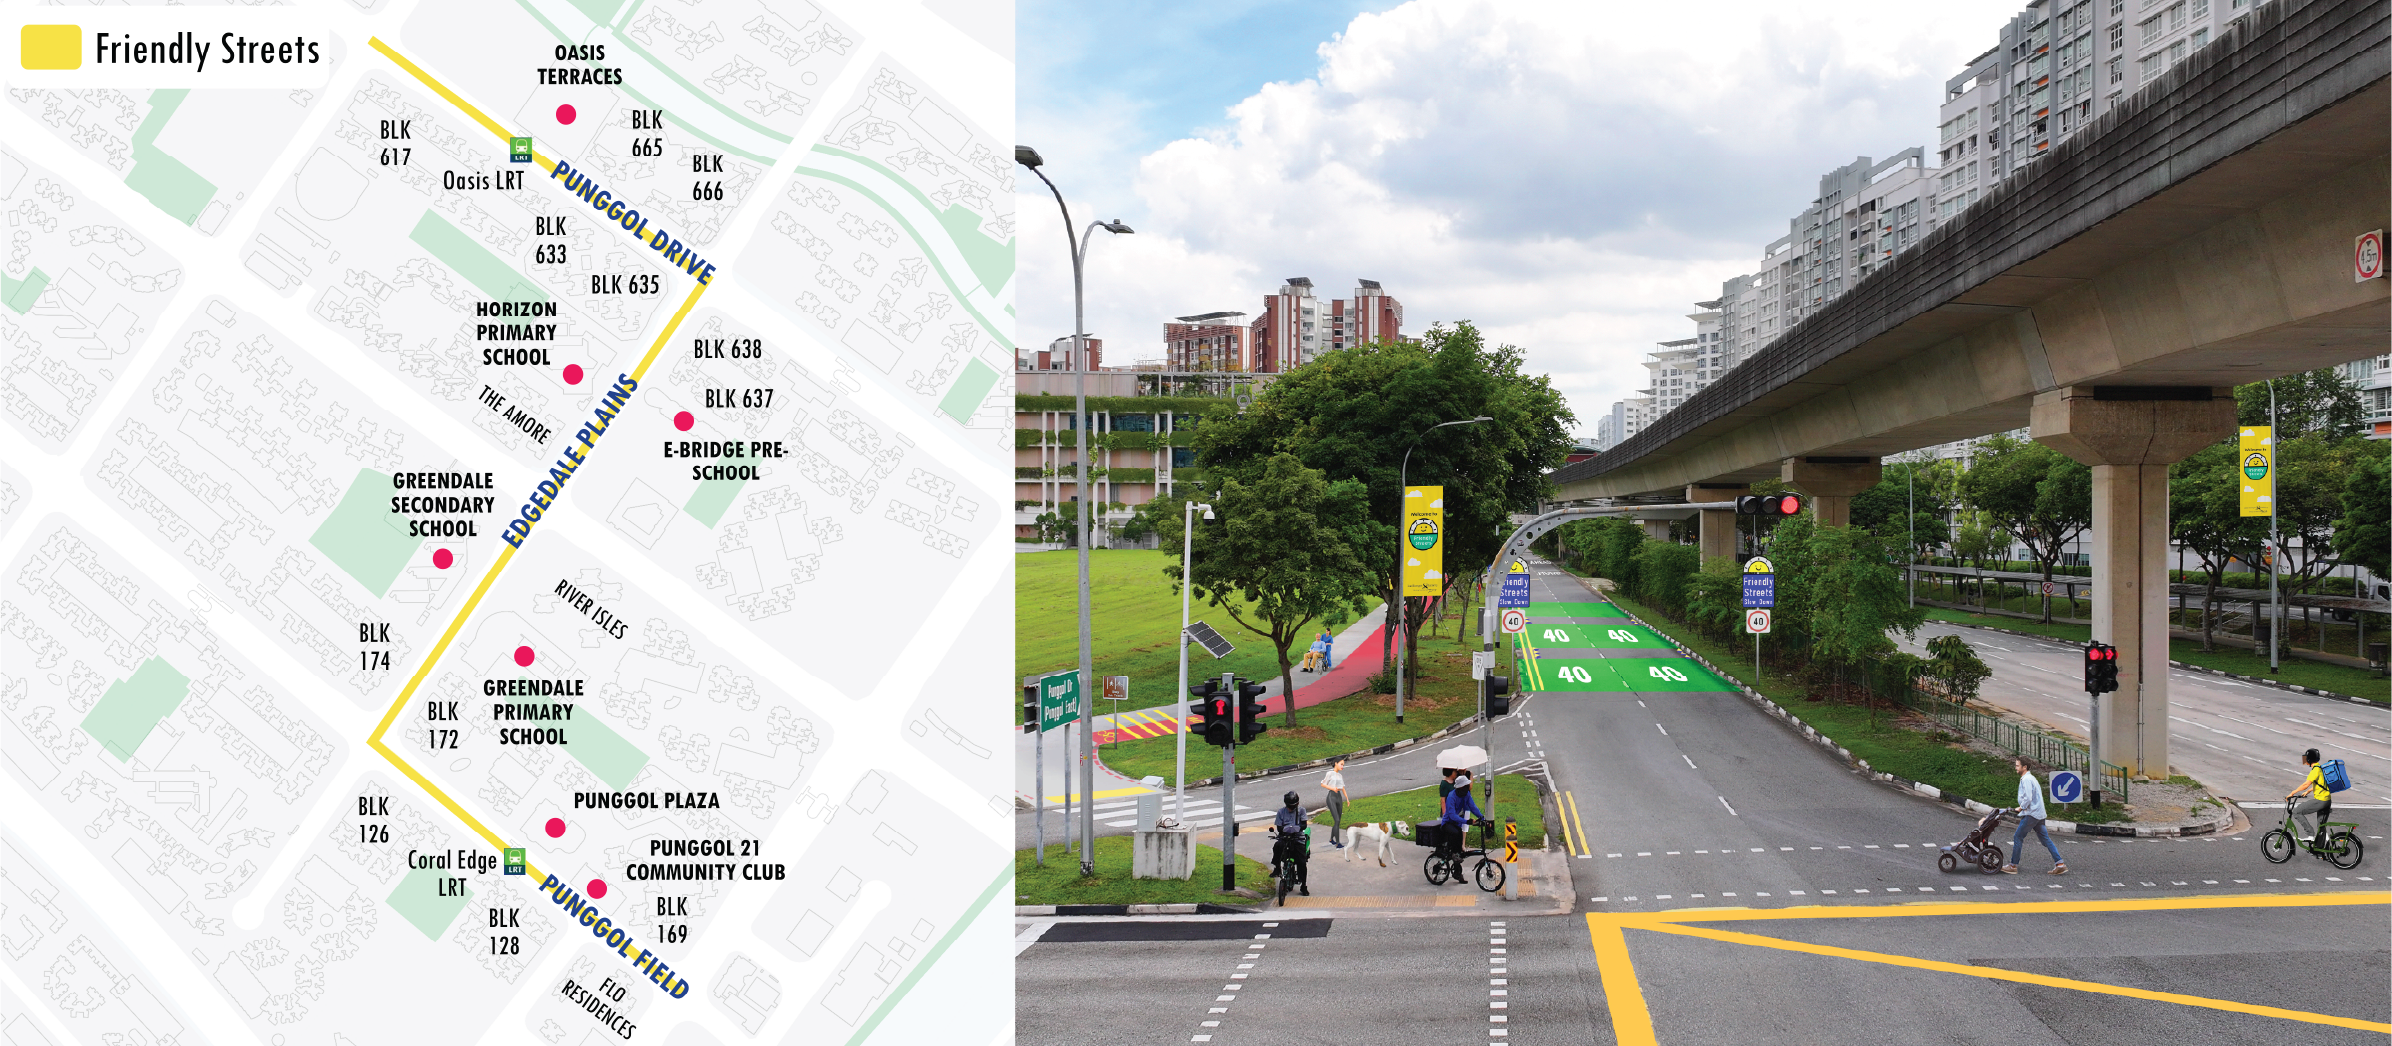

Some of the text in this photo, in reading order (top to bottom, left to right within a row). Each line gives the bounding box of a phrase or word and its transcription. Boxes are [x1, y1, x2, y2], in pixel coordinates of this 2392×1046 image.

[2361, 249, 2377, 264] 4.5m
[1744, 578, 1773, 588] Friendly
[1500, 588, 1528, 596] Streets
[1744, 588, 1772, 596] Streets
[1754, 618, 1764, 626] 40
[1544, 629, 1570, 642] 40
[1608, 630, 1638, 642] 40
[1558, 666, 1592, 683] 40
[1650, 666, 1688, 682] 40
[1048, 679, 1073, 699] Punggol Dr
[1045, 701, 1063, 721] (Punggol
